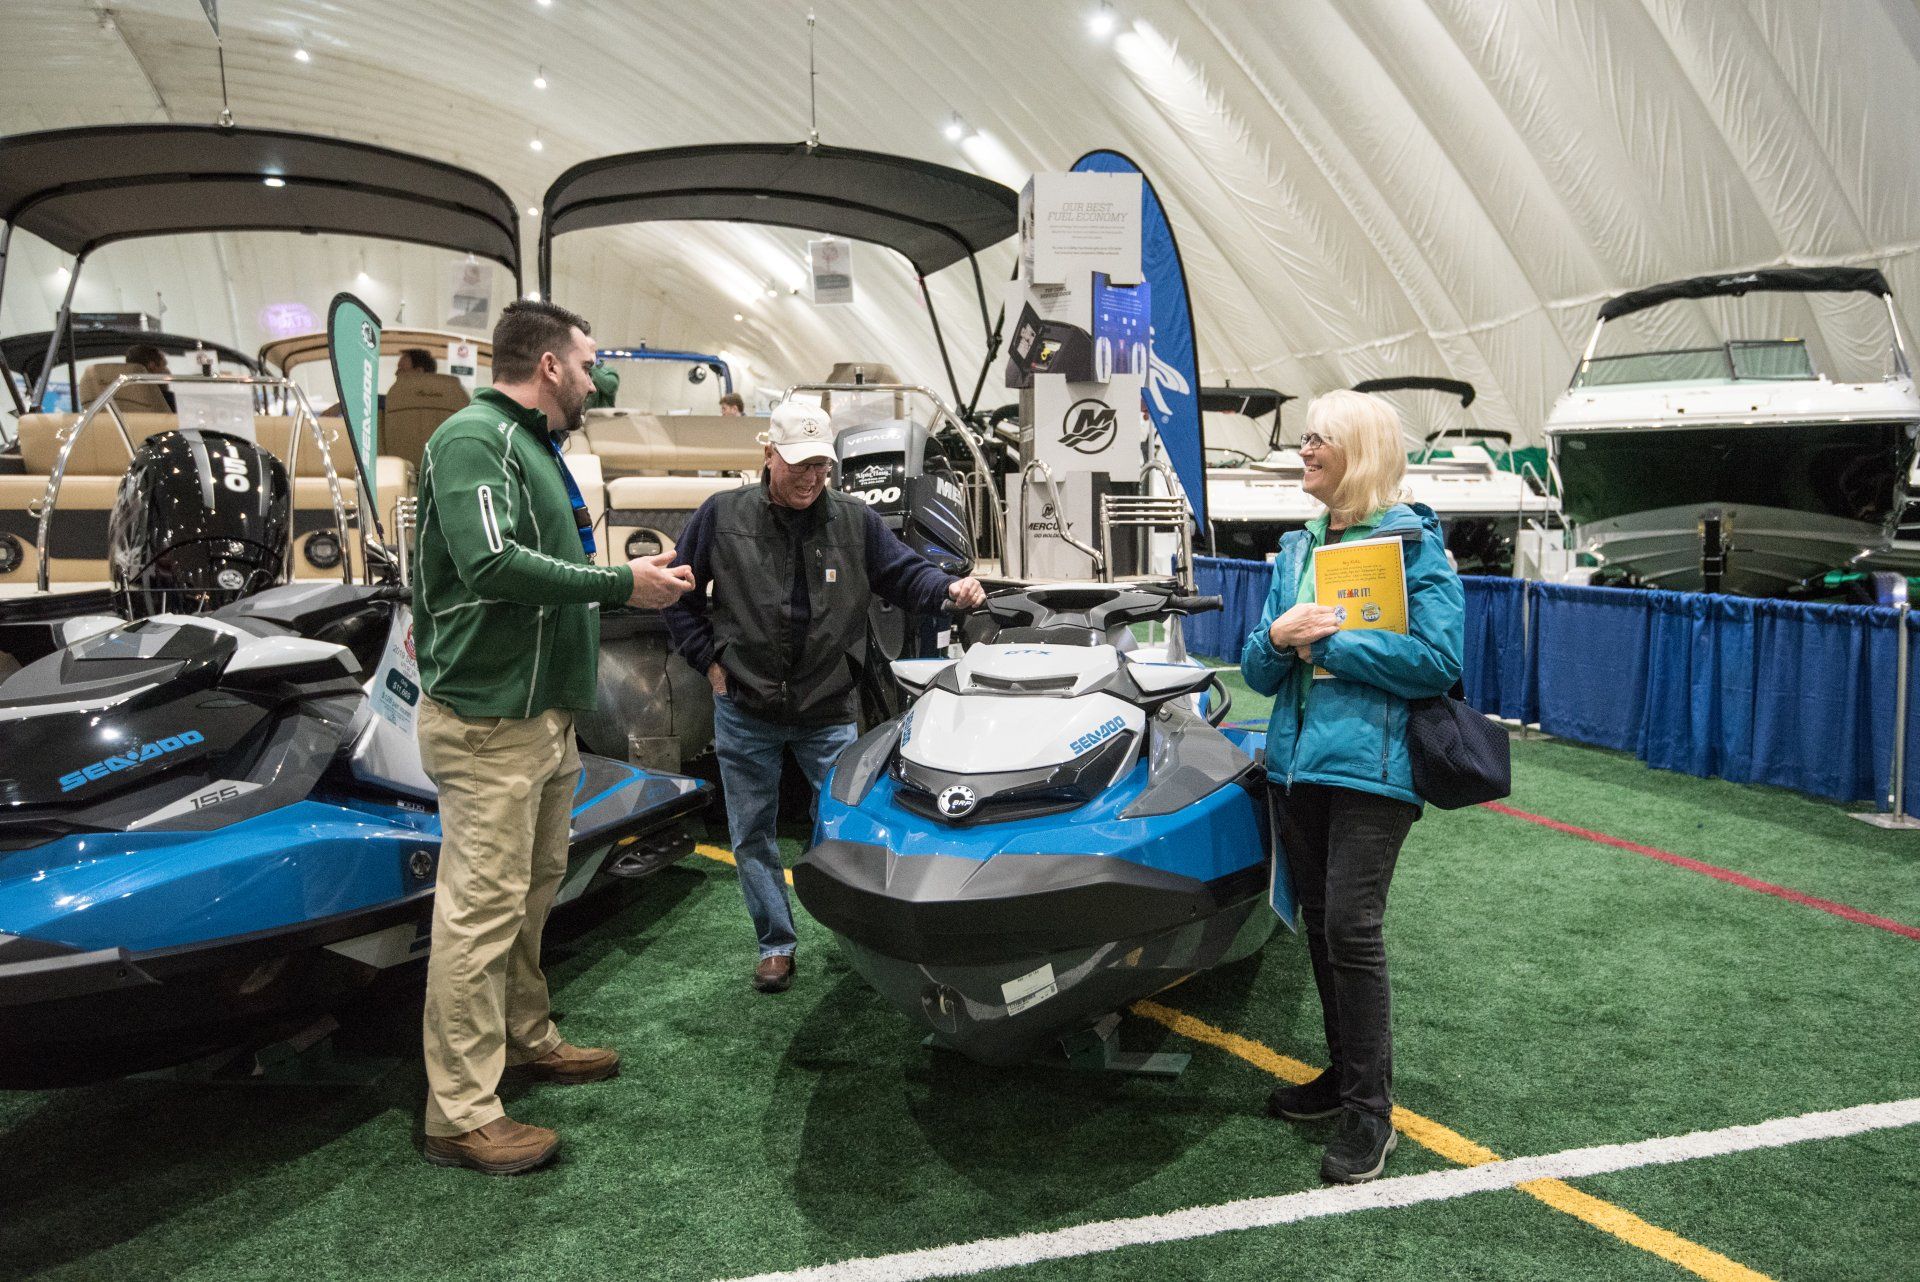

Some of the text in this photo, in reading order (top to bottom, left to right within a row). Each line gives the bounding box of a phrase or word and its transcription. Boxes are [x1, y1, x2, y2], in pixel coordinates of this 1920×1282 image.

[1062, 202, 1114, 212] OUR BEST
[1048, 211, 1128, 222] FUEL ECONOMY
[847, 433, 901, 446] VERADO
[223, 445, 250, 493] 150
[1027, 522, 1074, 531] MERCUY
[1337, 587, 1371, 598] WEAR IT!
[190, 785, 240, 810] 155
[952, 799, 972, 807] BRP
